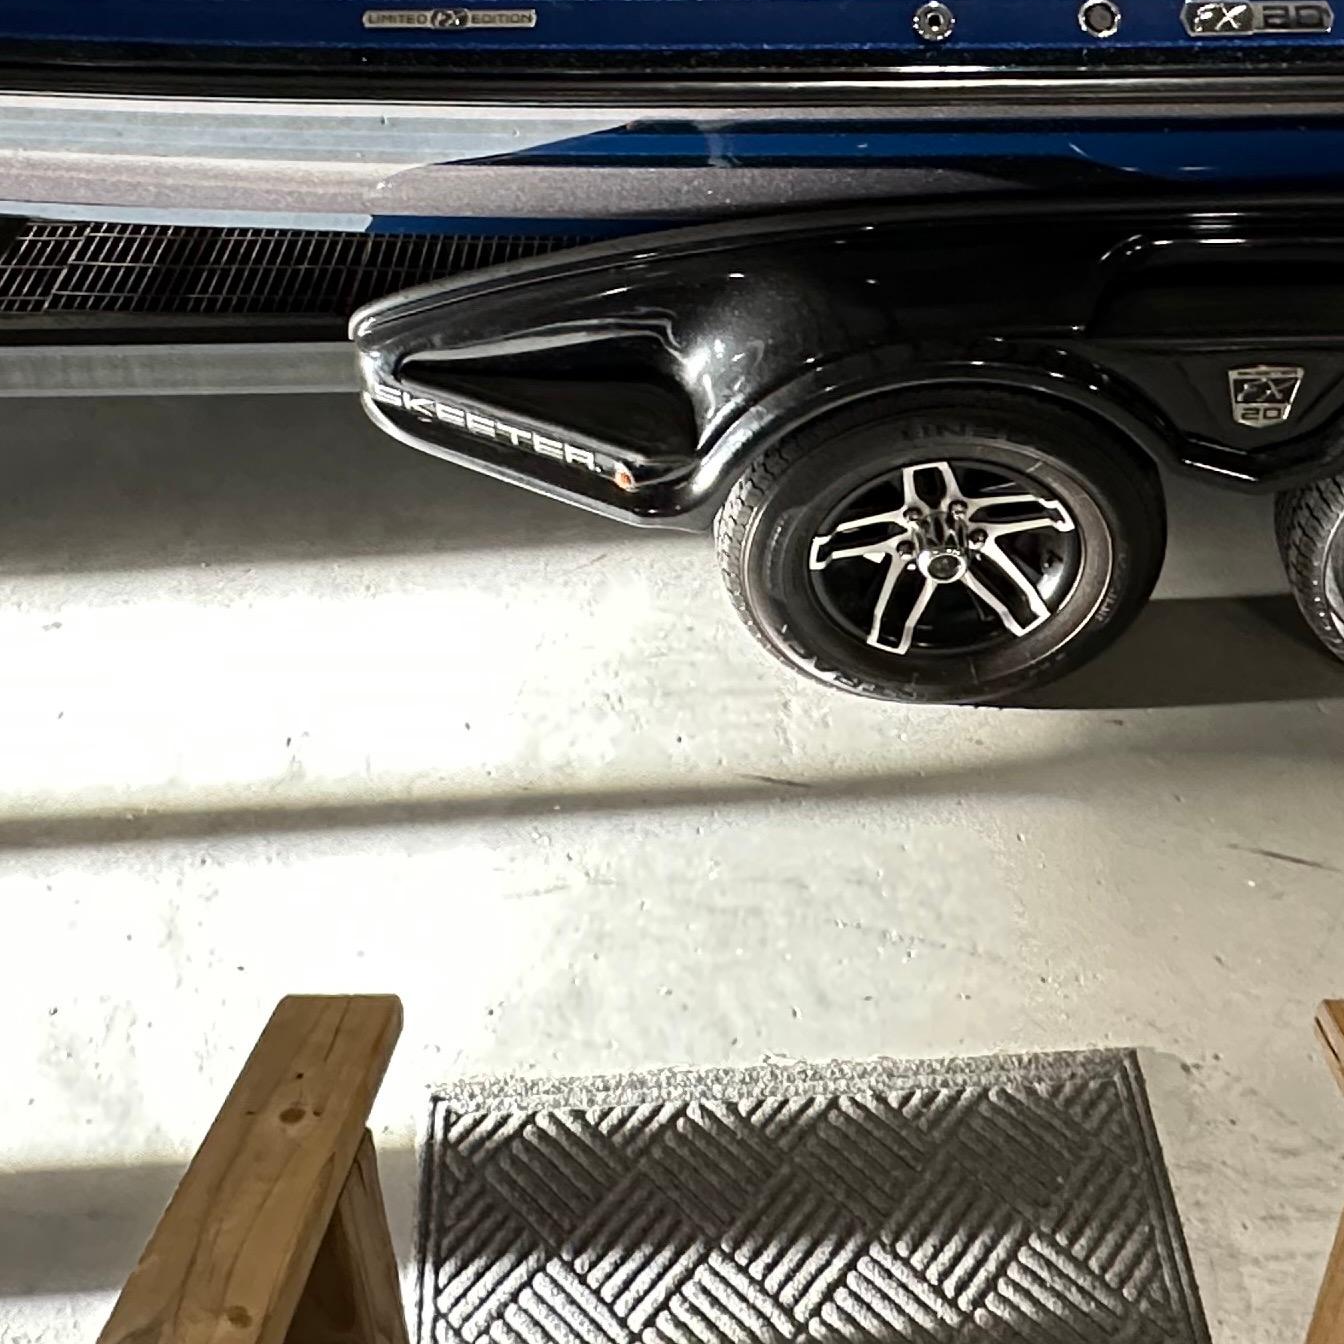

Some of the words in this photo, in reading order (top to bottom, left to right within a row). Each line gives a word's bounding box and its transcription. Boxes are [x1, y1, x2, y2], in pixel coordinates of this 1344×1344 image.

[367, 13, 429, 26] LIMITED
[471, 13, 533, 25] EDITION
[1194, 2, 1248, 33] FX
[1241, 406, 1282, 421] 20
[372, 384, 602, 471] SKEETER
